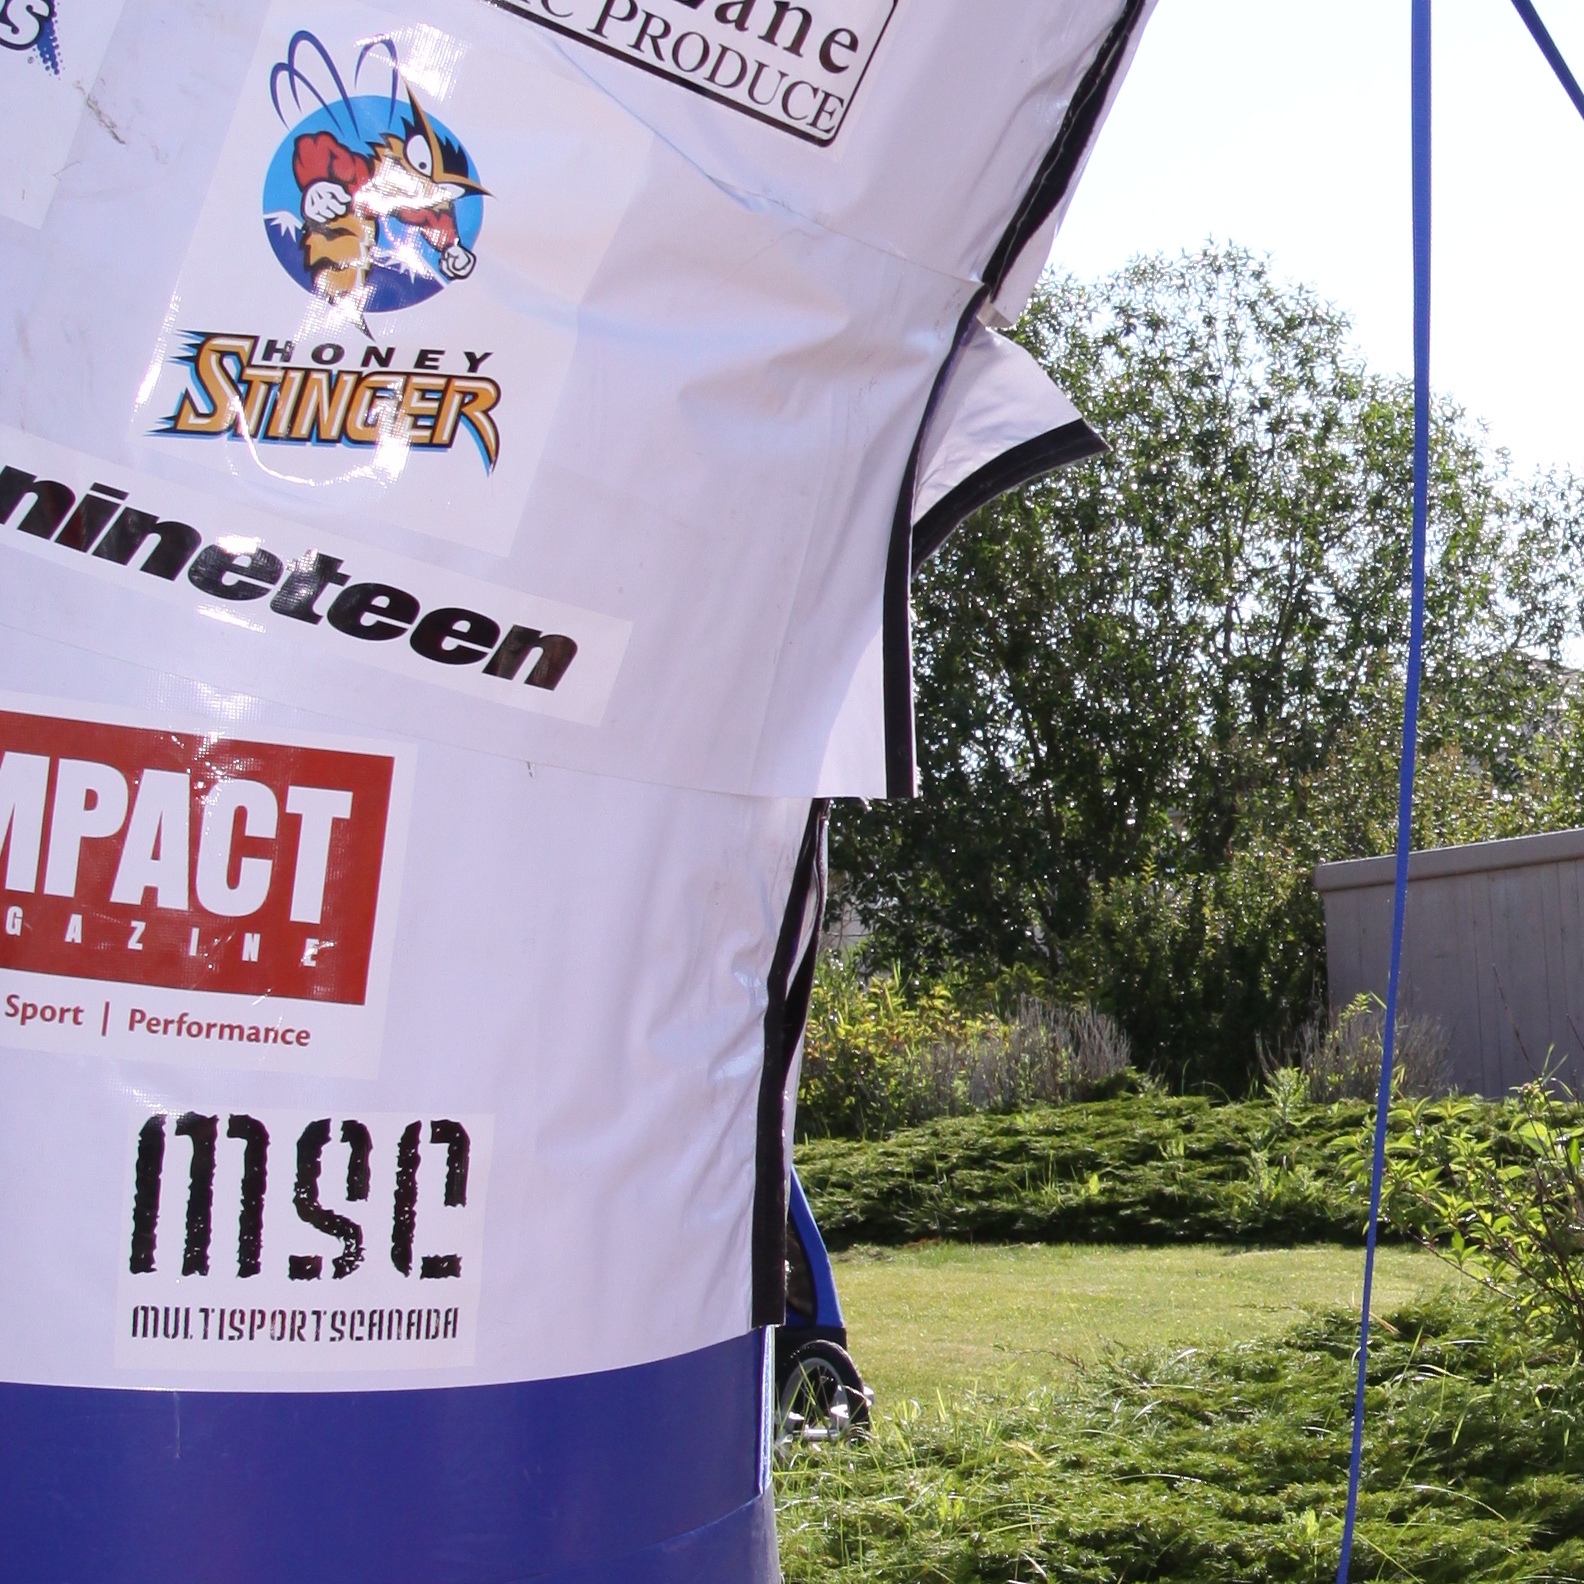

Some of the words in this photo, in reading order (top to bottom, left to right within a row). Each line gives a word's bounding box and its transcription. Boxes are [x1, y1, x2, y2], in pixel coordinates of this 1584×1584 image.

[261, 338, 495, 374] HONEY
[150, 330, 503, 474] STINGER
[0, 464, 579, 692] nineteen
[4, 993, 85, 1027] Sport
[127, 1008, 312, 1048] Performance
[131, 1305, 461, 1343] MULTISPORTSCANADA
